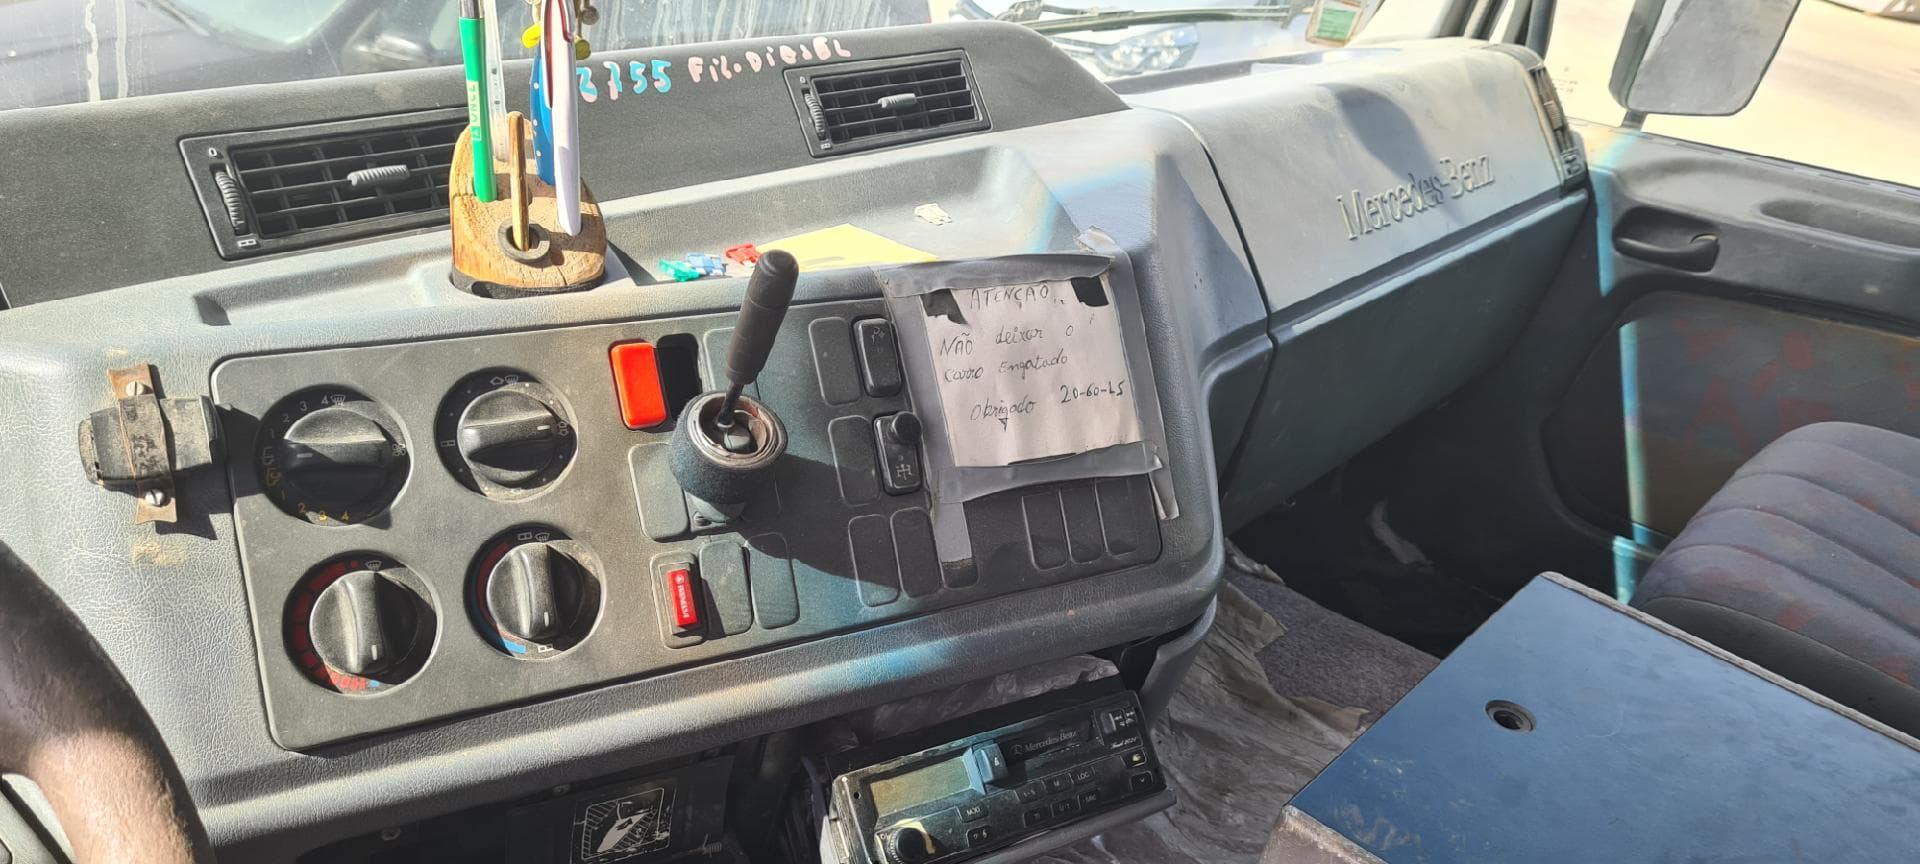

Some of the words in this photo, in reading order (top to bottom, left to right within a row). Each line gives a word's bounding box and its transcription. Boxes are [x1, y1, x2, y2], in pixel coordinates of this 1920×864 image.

[576, 58, 672, 104] 2755
[1336, 154, 1496, 241] Mercedes-Benz
[282, 413, 290, 423] 2
[300, 400, 308, 412] 3
[321, 394, 329, 405] 4
[298, 502, 306, 513] 2
[340, 510, 350, 521] 4
